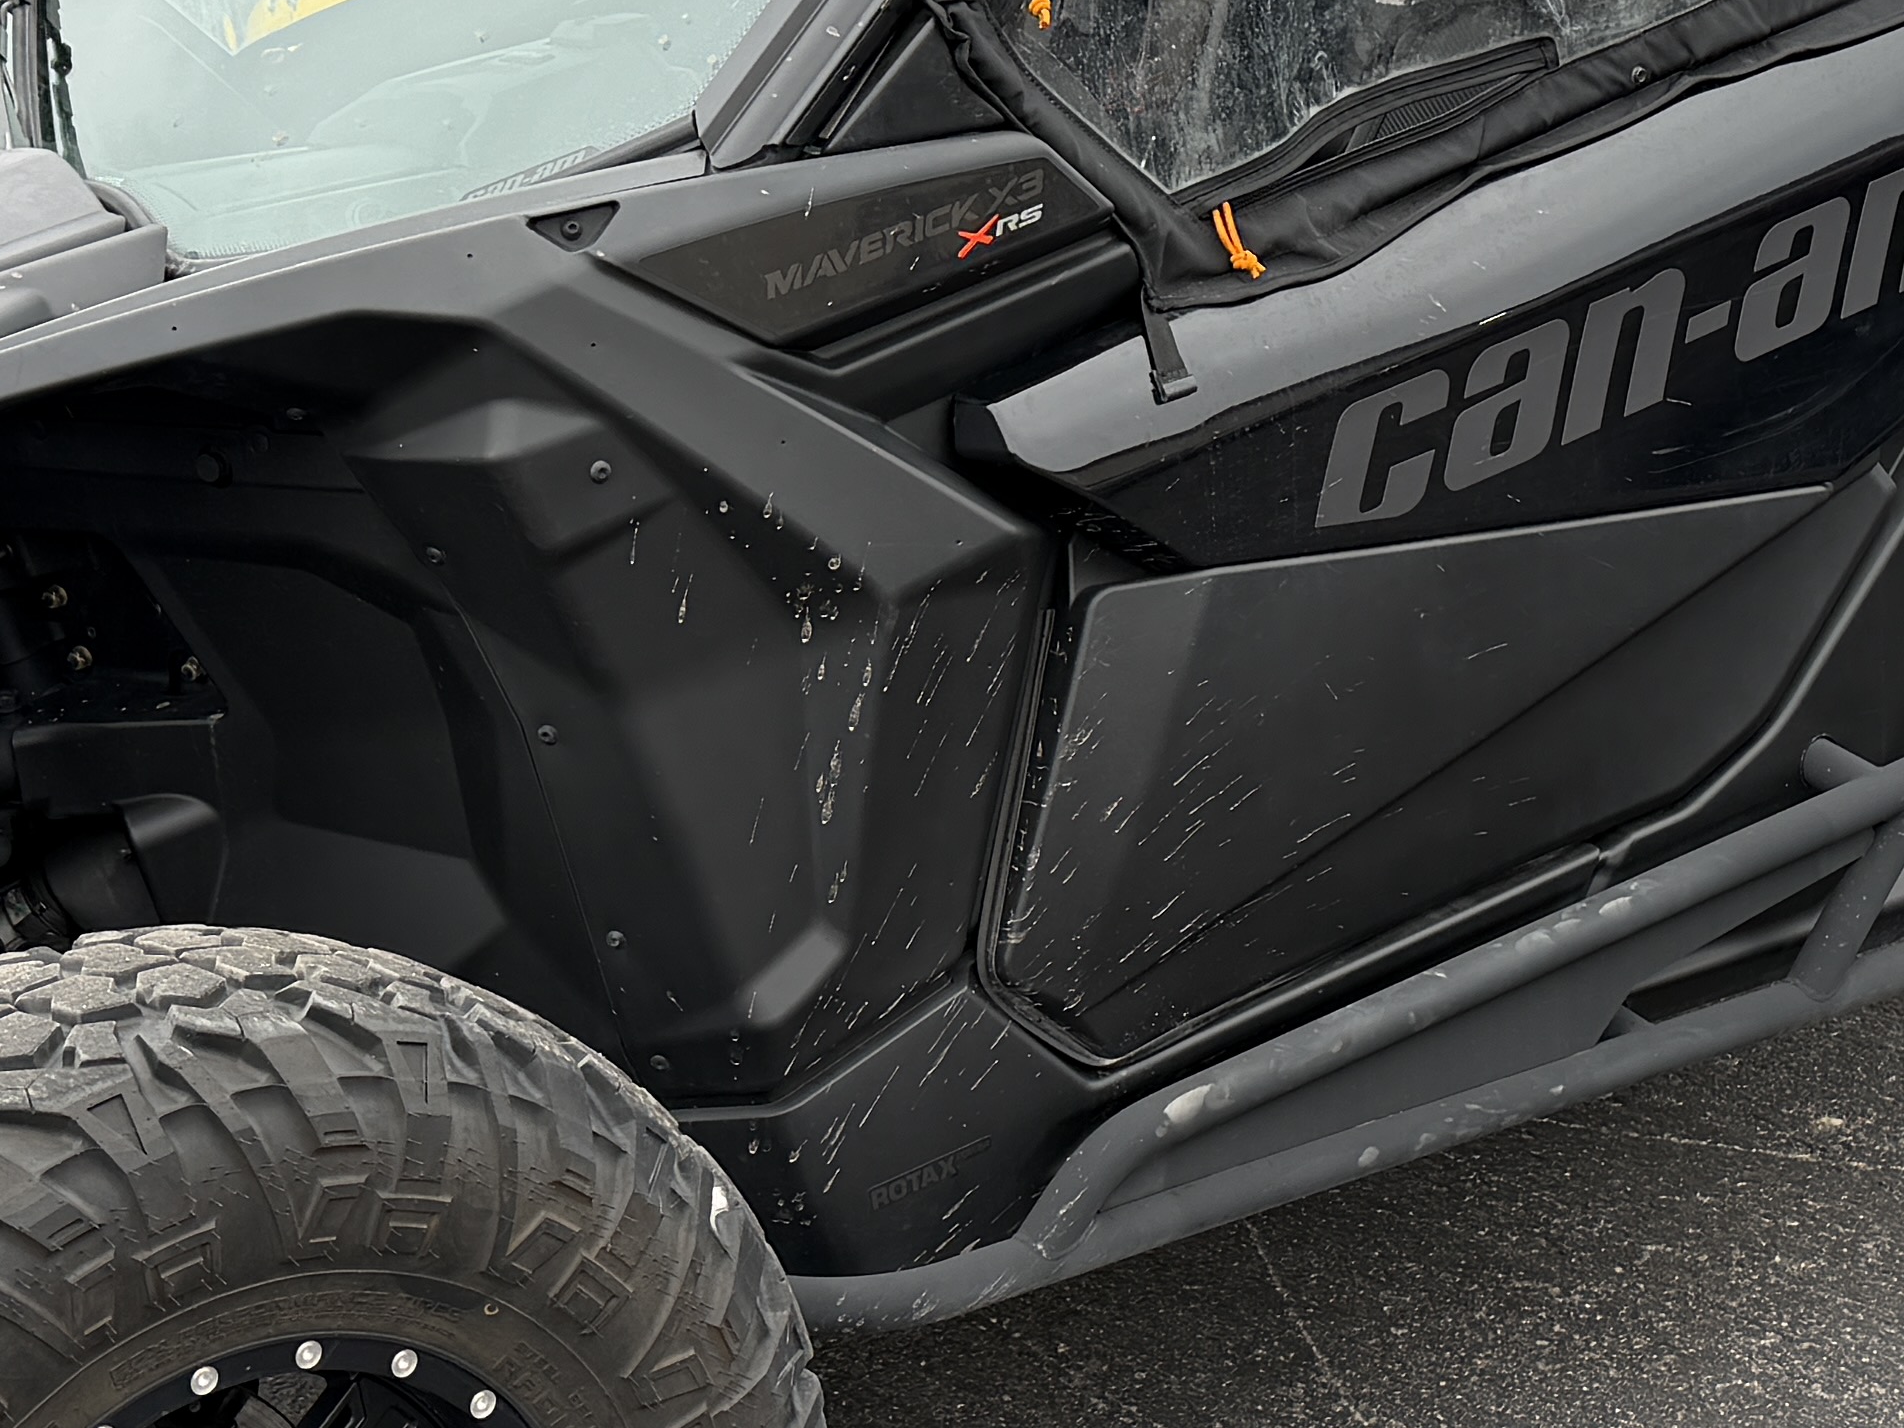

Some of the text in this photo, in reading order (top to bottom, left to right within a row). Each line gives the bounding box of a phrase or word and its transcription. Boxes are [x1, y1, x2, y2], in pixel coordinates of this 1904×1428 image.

[763, 168, 1045, 300] MAVERICK X3
[871, 1155, 959, 1210] ROTAX
